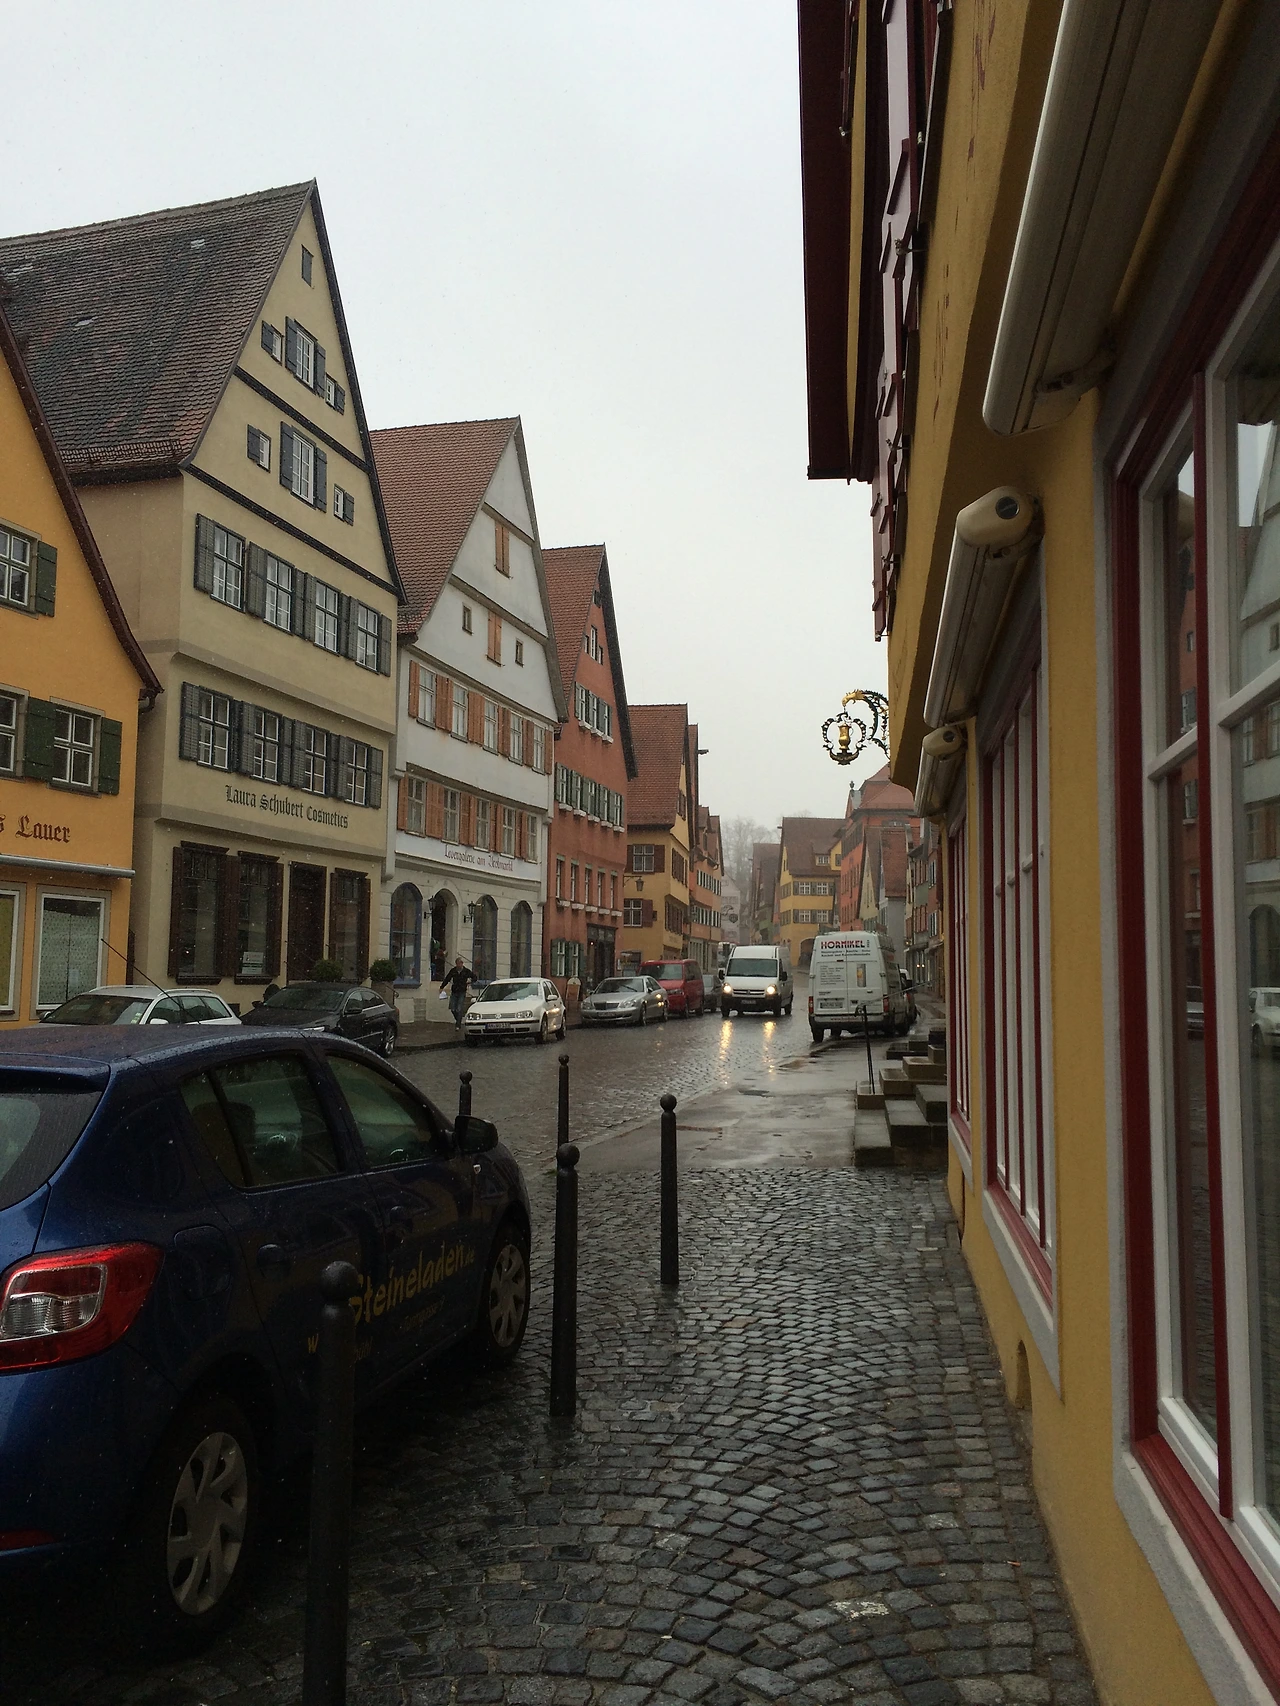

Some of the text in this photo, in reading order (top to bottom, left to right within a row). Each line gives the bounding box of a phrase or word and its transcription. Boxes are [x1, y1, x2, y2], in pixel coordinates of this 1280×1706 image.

[225, 785, 349, 829] Laura Schubert Cosmetics
[15, 814, 71, 844] Lauer
